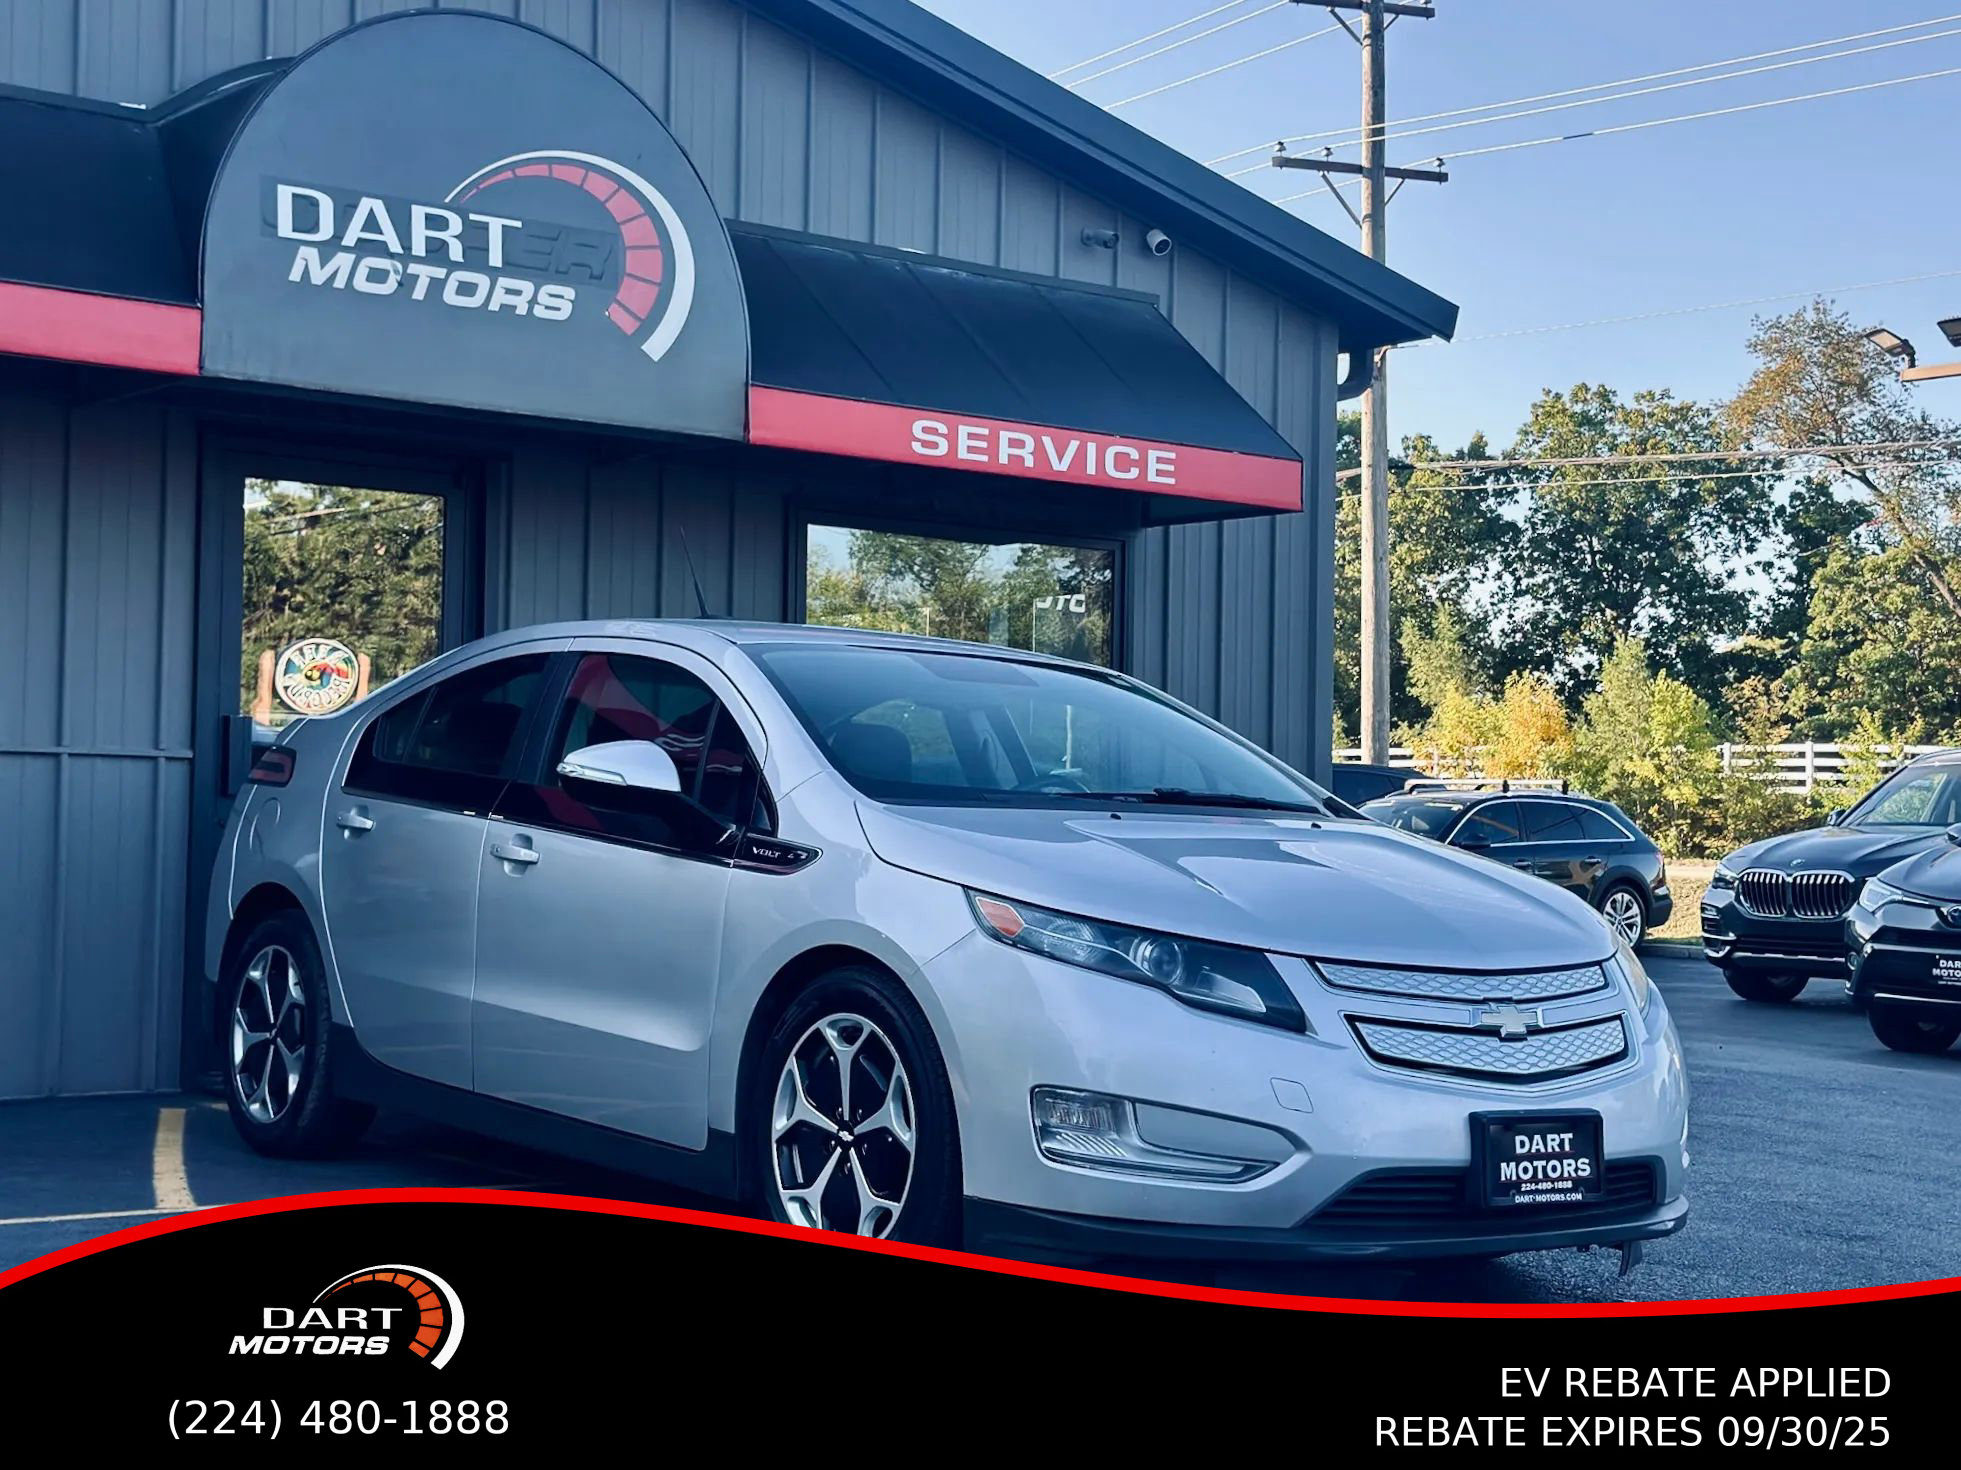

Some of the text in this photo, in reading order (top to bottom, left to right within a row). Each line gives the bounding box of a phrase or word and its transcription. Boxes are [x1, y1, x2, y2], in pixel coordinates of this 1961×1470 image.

[277, 184, 522, 267] DART
[288, 246, 576, 321] MOTORS
[911, 419, 1177, 485] SERVICE
[752, 846, 781, 858] VOLT
[1515, 1133, 1573, 1154] DART
[1501, 1158, 1591, 1181] MOTORS
